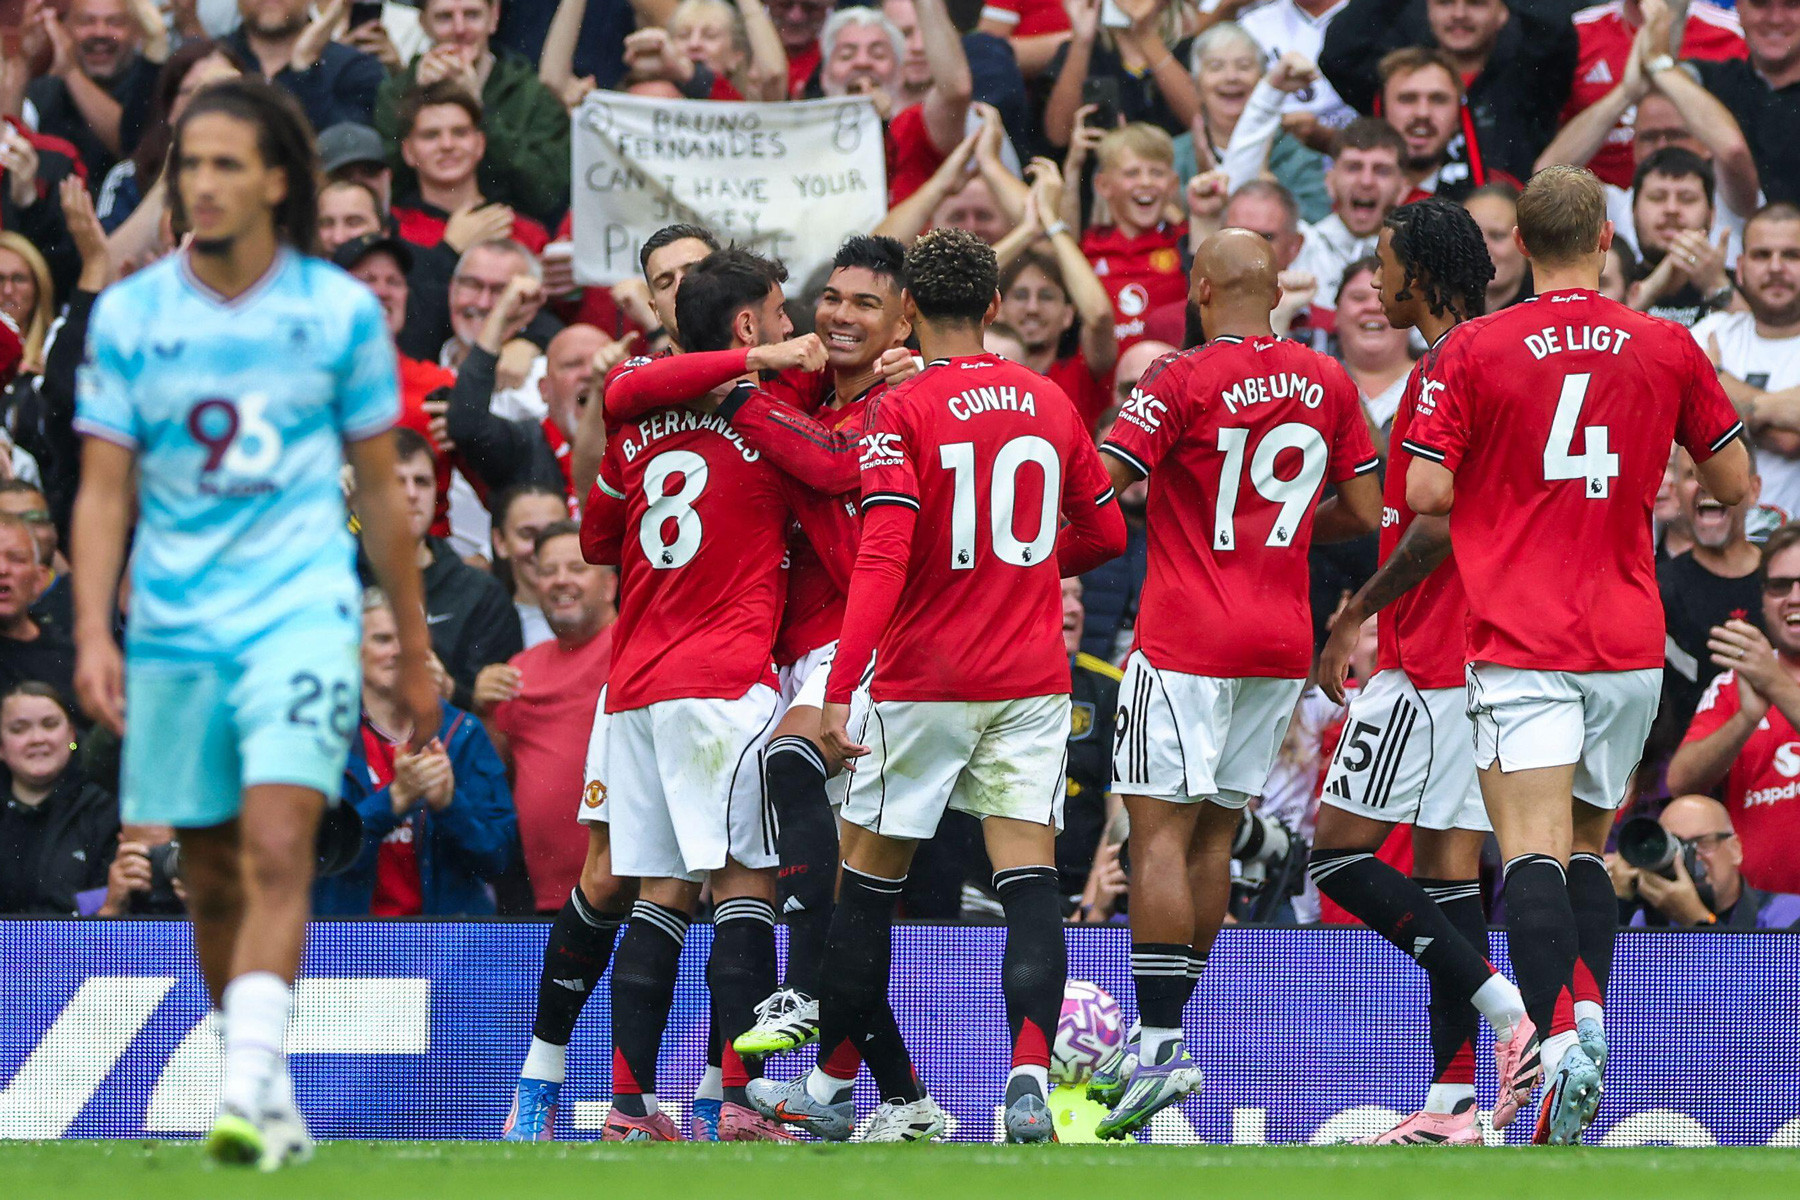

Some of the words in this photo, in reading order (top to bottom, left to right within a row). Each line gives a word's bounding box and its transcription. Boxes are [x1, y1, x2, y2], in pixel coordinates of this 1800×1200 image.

[653, 109, 761, 134] BRUNO
[619, 132, 786, 158] FERNANDES
[585, 161, 645, 193] CAN
[693, 177, 769, 203] HAVE
[792, 168, 868, 197] YOUR
[1524, 326, 1562, 360] DE
[1565, 325, 1632, 355] LIGT
[947, 385, 1036, 421] CUNHA
[1221, 372, 1324, 415] MBEUMO
[187, 392, 282, 475] 96
[1543, 373, 1620, 499] 4
[938, 434, 1061, 570] 10
[1213, 422, 1329, 551] 19
[639, 449, 710, 570] 8
